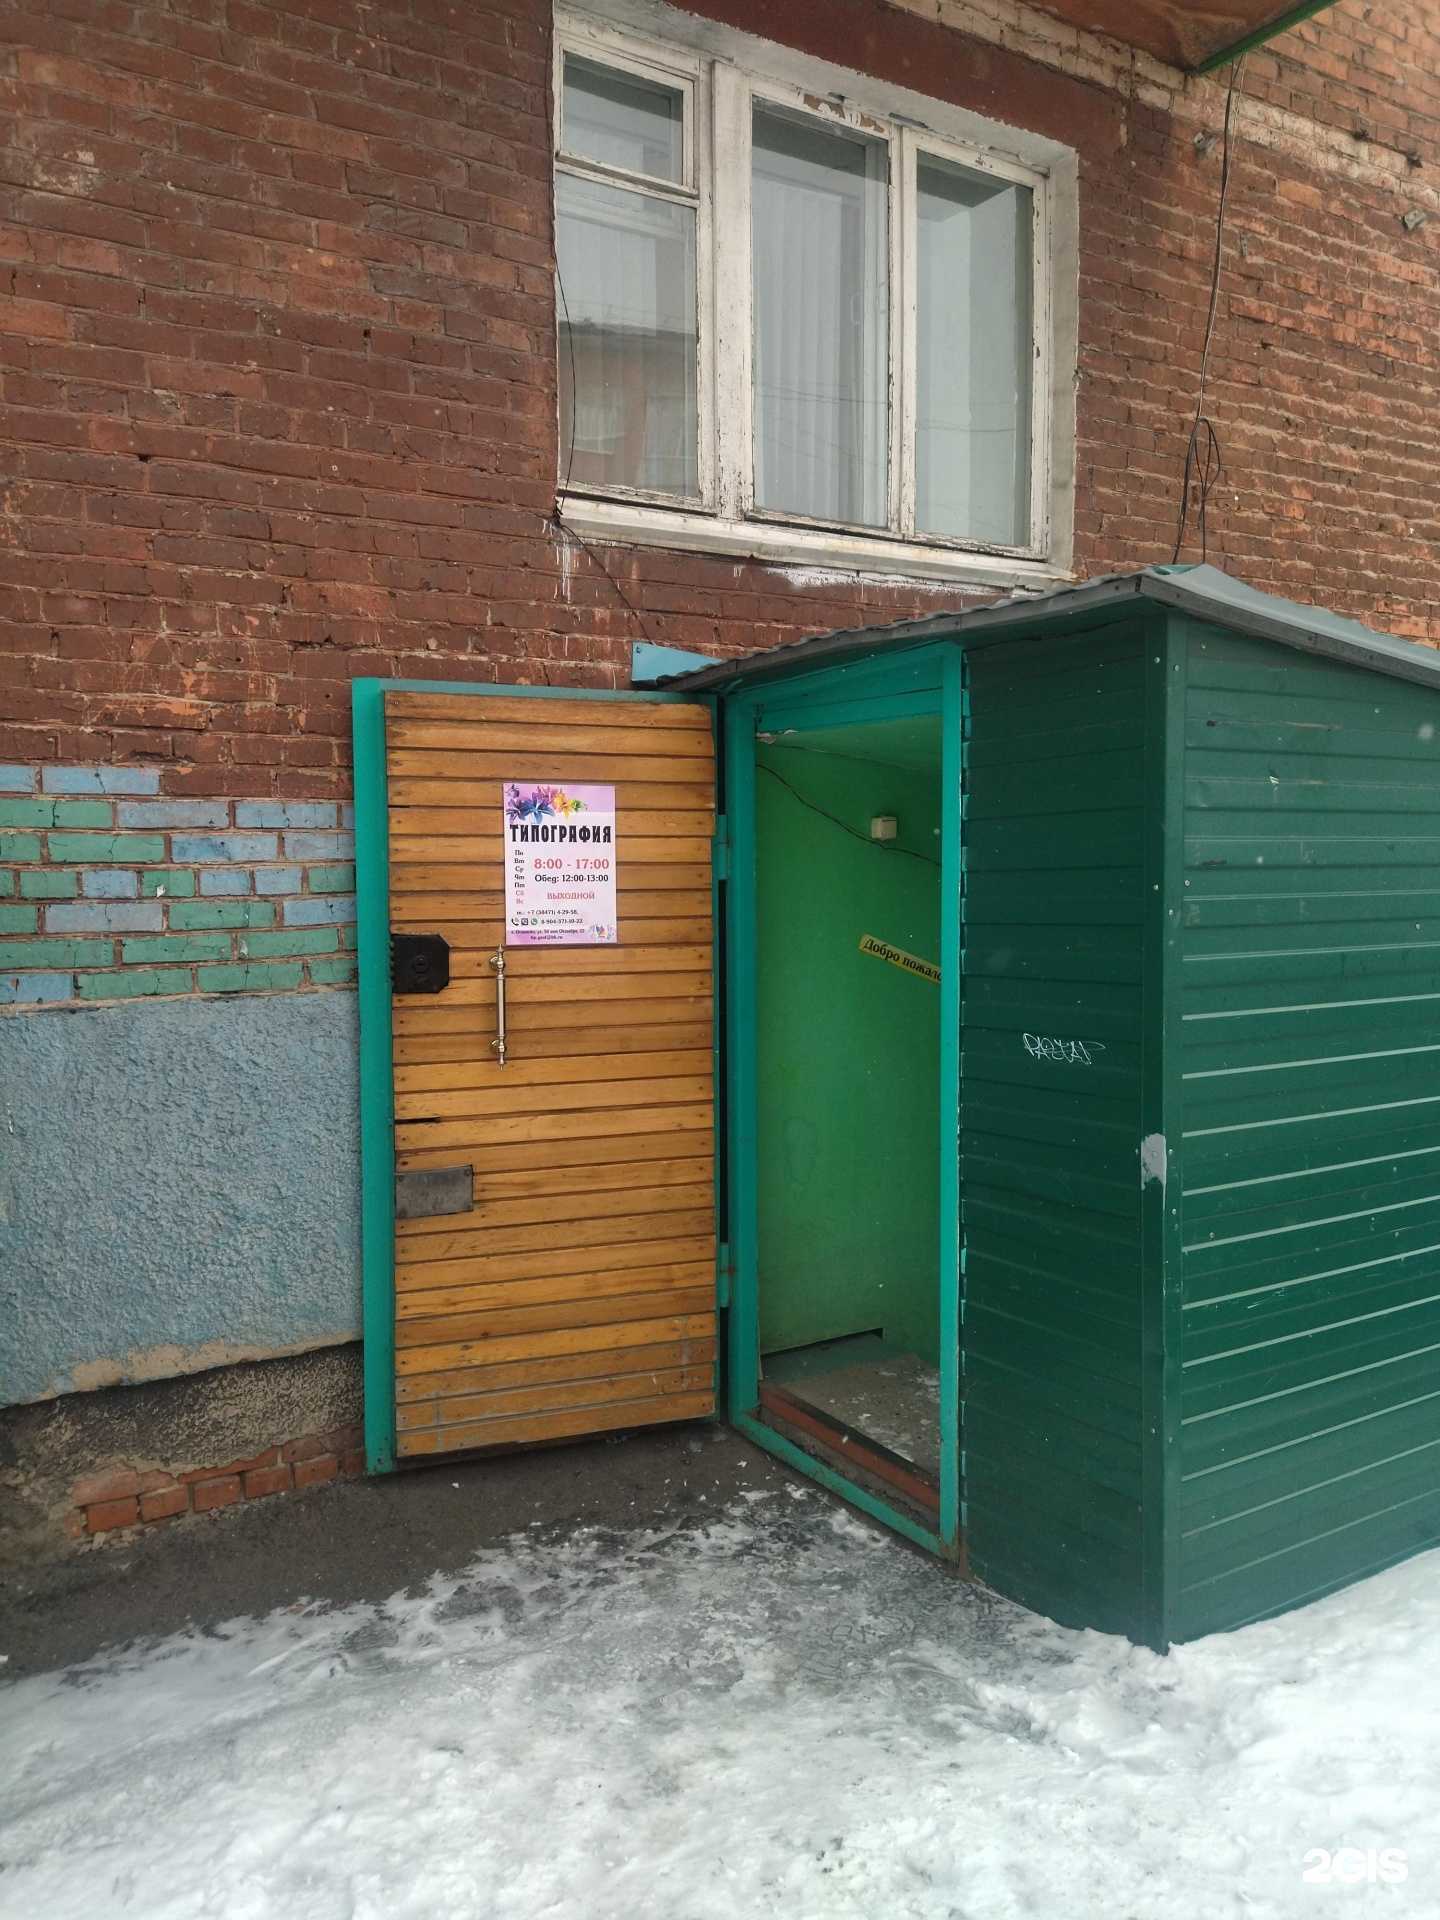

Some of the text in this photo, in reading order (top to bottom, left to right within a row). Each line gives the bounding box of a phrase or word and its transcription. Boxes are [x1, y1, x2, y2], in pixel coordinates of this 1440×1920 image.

[510, 824, 611, 843] ТИПОГРАФИЯ
[534, 858, 563, 870] 8:00
[576, 859, 610, 870] 17:00
[535, 874, 609, 884] Обед: 12:00-13:00
[547, 892, 595, 900] ВЫХОДНОЙ
[863, 938, 901, 962] Добро
